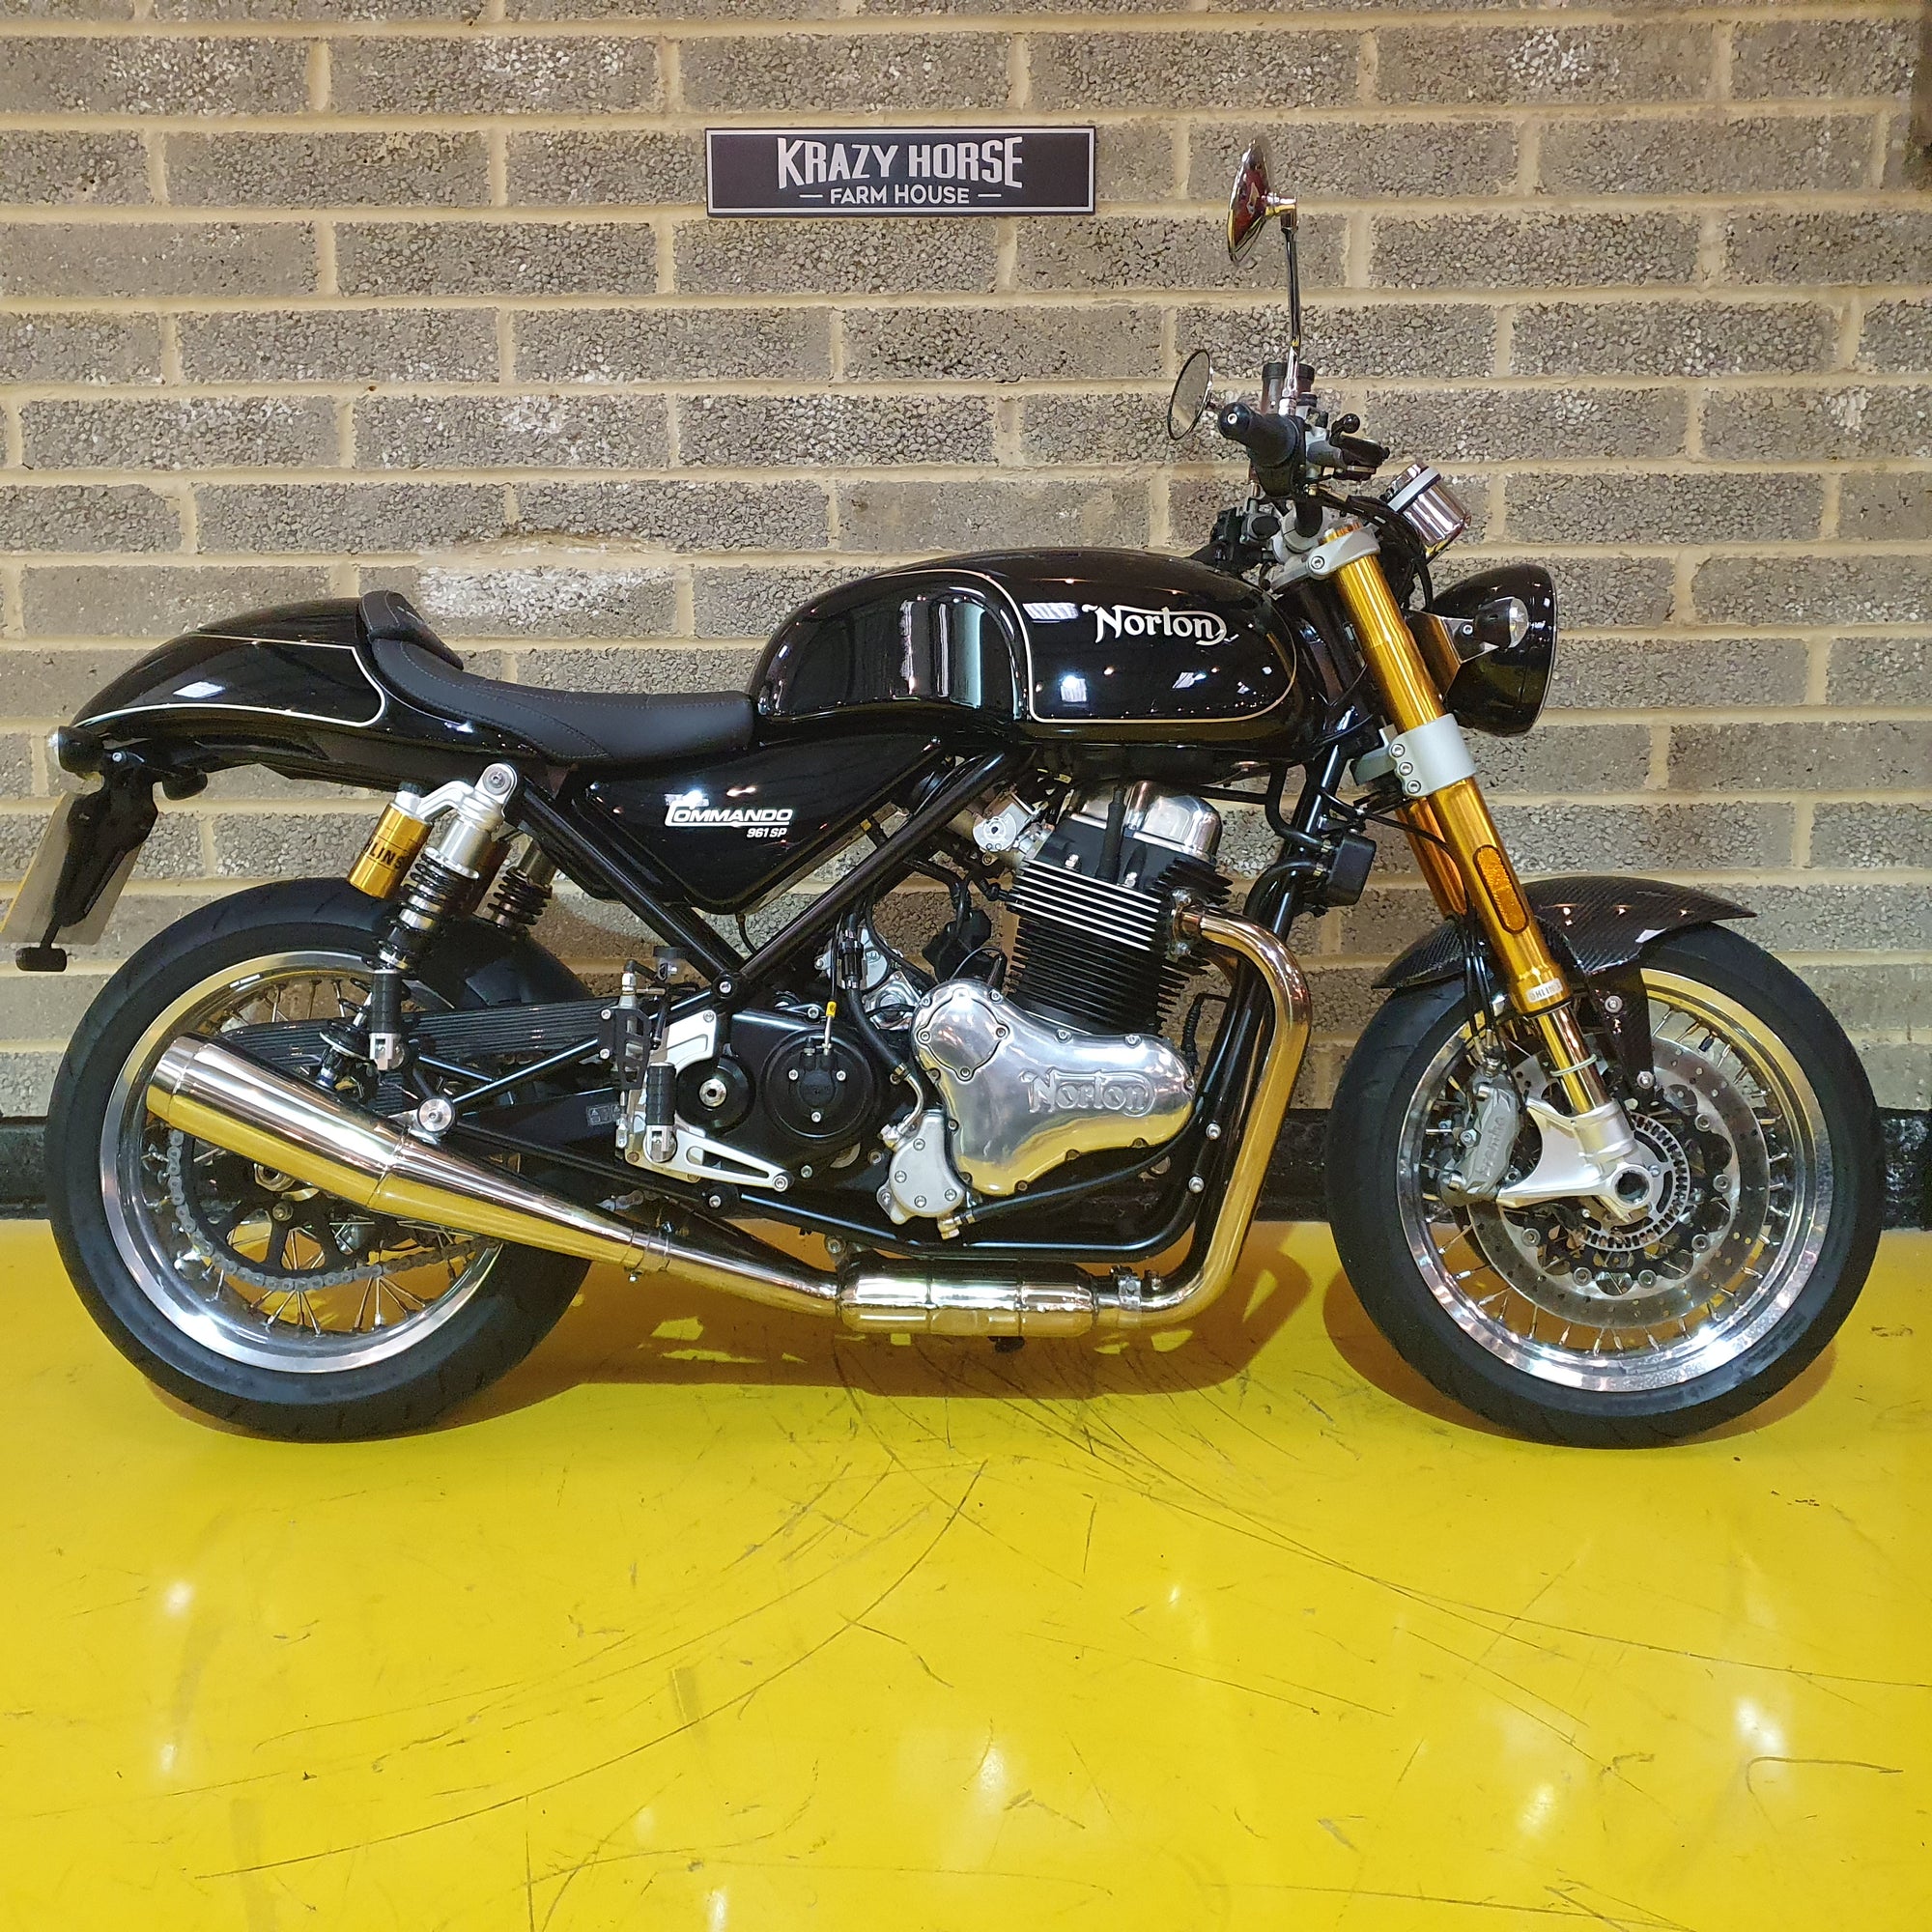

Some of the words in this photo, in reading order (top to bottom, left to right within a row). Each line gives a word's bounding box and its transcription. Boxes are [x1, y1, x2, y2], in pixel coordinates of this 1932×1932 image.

[777, 136, 898, 188] KRAZY
[908, 136, 1023, 188] HORSE
[830, 184, 887, 204] FARM
[895, 184, 970, 204] HOUSE
[1081, 603, 1228, 646] Norton
[747, 828, 768, 838] 961
[769, 828, 787, 838] SP
[1018, 1065, 1156, 1117] Norton
